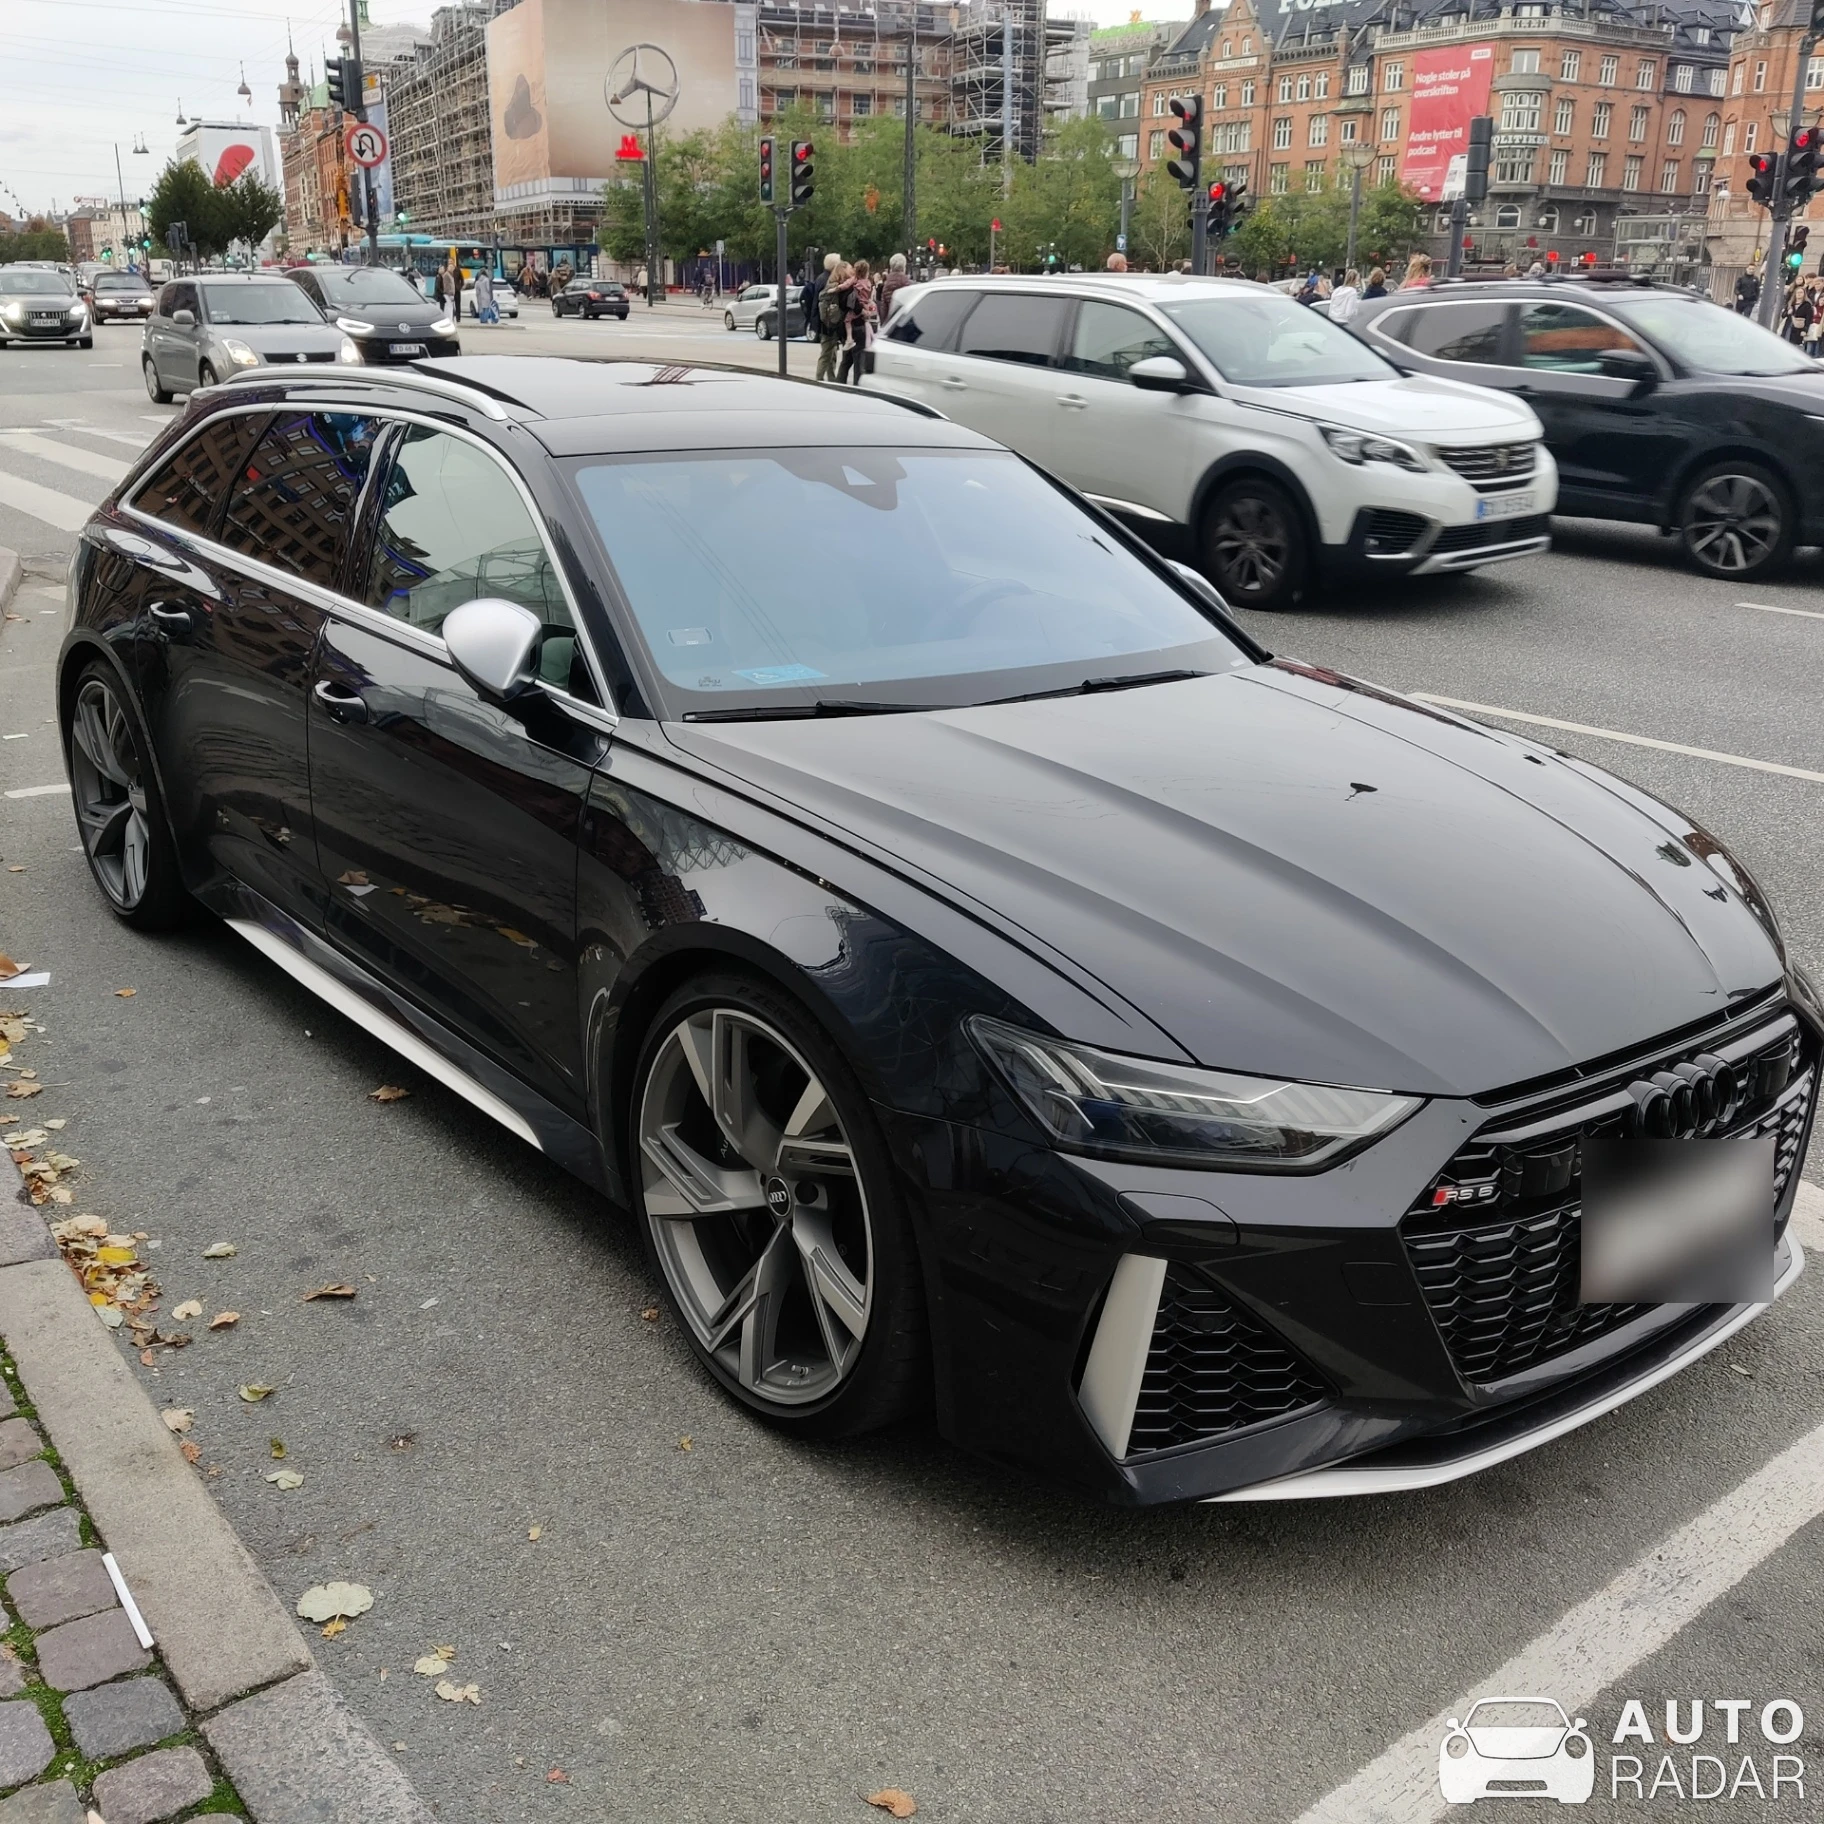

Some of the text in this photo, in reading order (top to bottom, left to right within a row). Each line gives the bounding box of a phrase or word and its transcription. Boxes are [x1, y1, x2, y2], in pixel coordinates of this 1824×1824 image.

[1415, 67, 1471, 84] Nogle stoler på
[1414, 85, 1459, 98] overskriften
[1409, 127, 1463, 142] Andre lytter til
[1407, 145, 1437, 158] podcast
